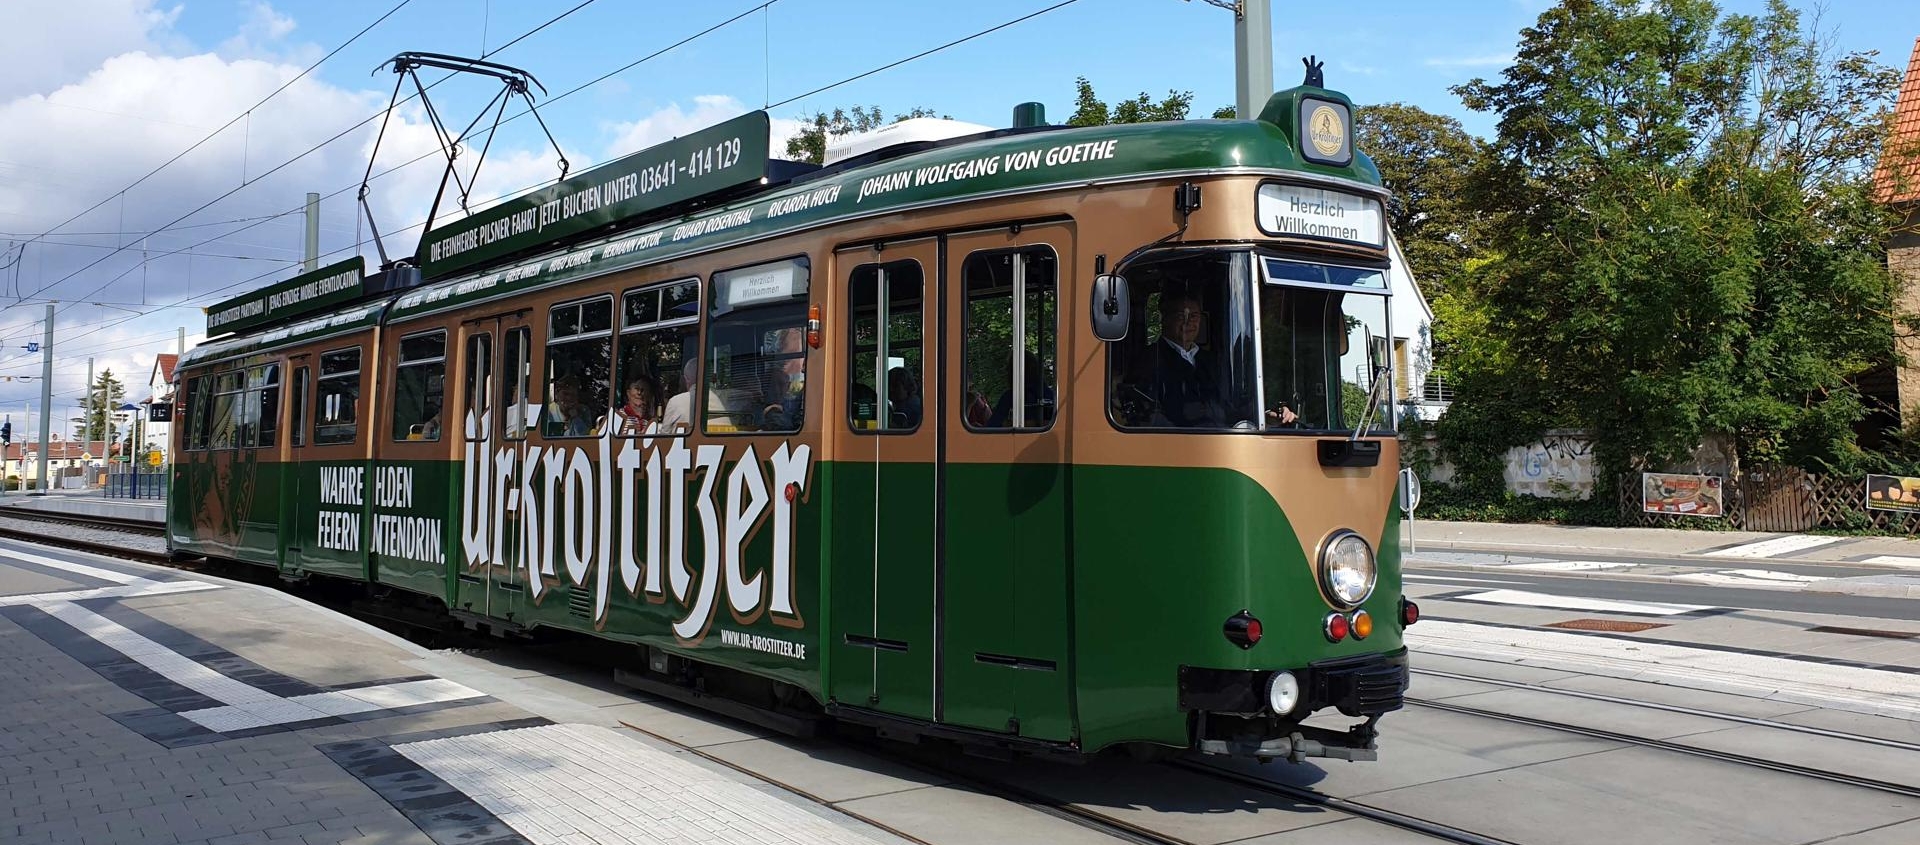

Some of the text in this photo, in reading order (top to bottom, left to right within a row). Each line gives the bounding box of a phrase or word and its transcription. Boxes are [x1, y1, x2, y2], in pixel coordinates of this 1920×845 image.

[857, 139, 1118, 204] JOHANN WOLFGANG VON GOETHE
[430, 242, 442, 263] DIE
[442, 227, 478, 260] FEINHERBE
[479, 216, 510, 247] PILSNER
[512, 206, 537, 236] FAHRT
[538, 198, 561, 234] JETZT
[563, 184, 601, 220] BUCHEN
[604, 172, 638, 206] UNTER
[641, 159, 676, 194] 03641
[716, 137, 741, 170] 129
[767, 185, 842, 219] RICARDA HUCH
[1290, 195, 1345, 218] Herzlich
[672, 207, 755, 242] EDUARD ROSENTHAL
[1275, 214, 1358, 240] Willkommen
[602, 231, 664, 260] HERMANN PISTOR
[268, 292, 282, 315] JENAS
[282, 287, 300, 307] EINZIGE
[300, 281, 319, 302] MOBILE
[319, 268, 360, 297] EVENTLOCATION
[742, 285, 780, 299] Willkommen
[320, 465, 365, 506] WAHRE
[317, 510, 360, 552] FEIERN
[720, 628, 806, 660] WWW.UR-KROSTITZER.DE
